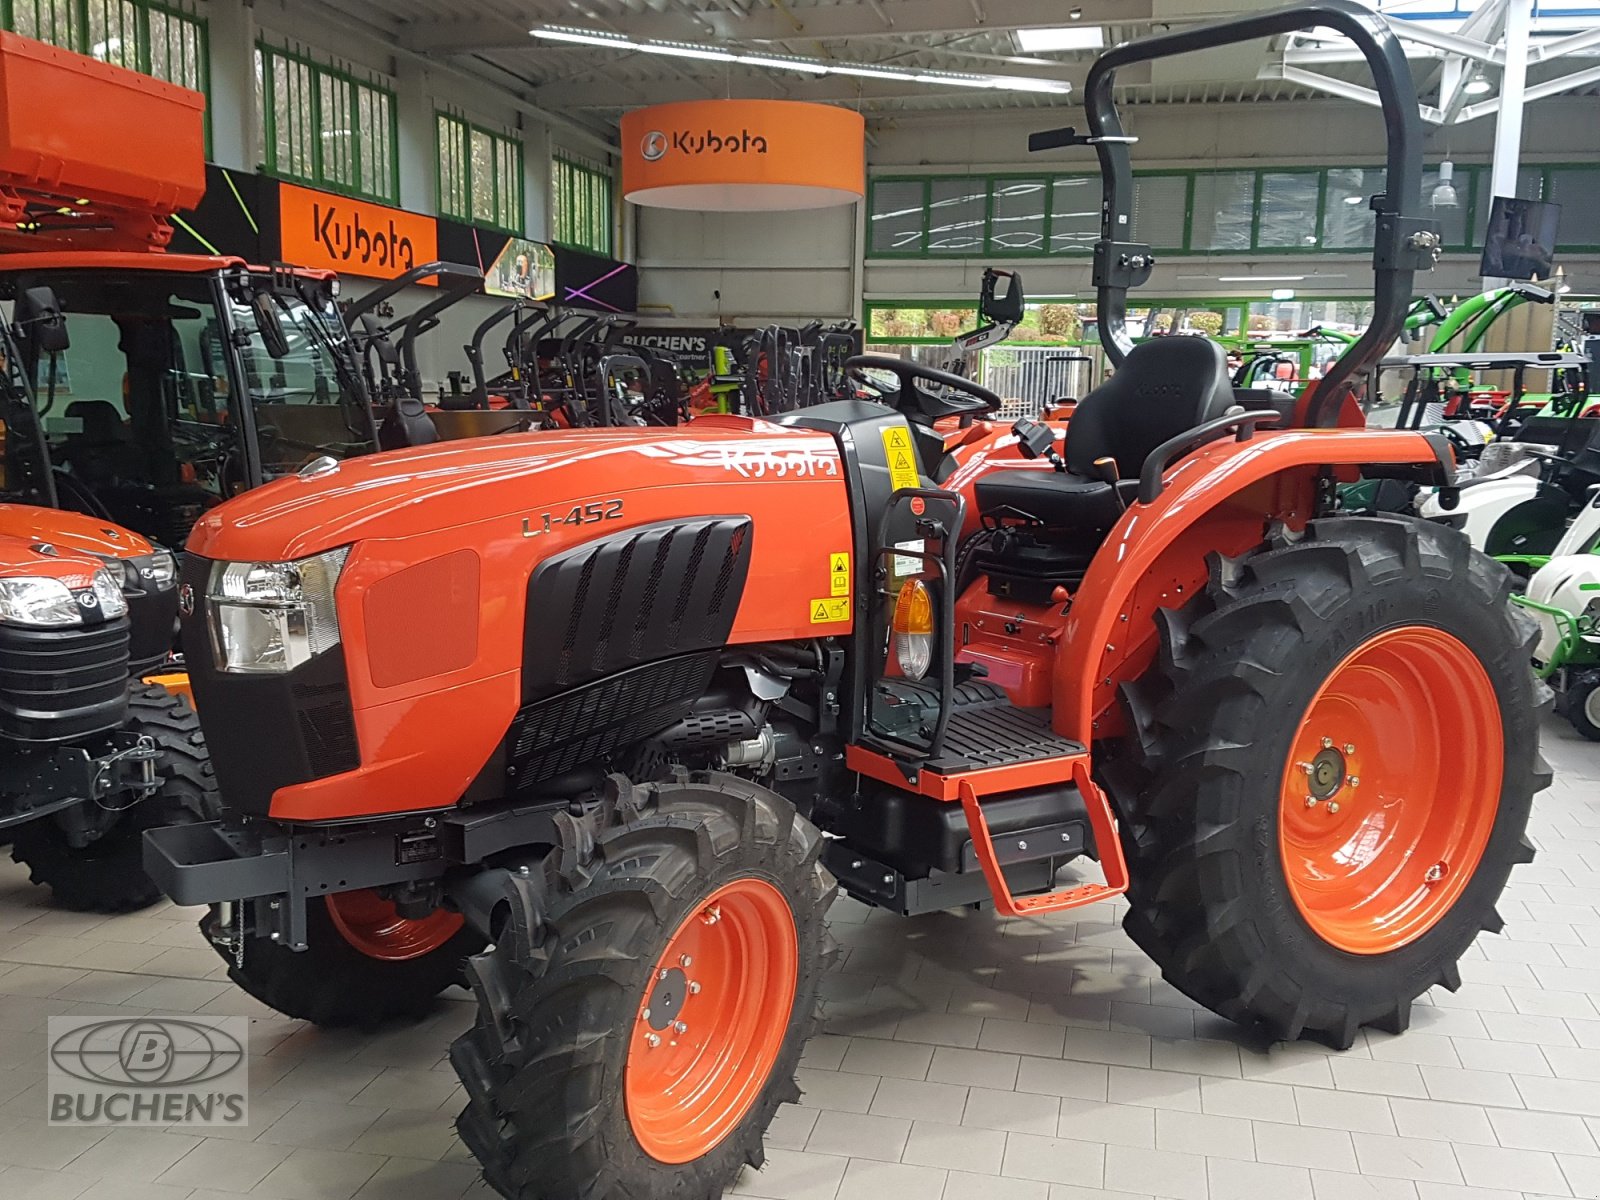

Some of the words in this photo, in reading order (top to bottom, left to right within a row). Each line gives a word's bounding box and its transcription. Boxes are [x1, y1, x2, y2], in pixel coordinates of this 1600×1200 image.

[672, 129, 768, 154] Kubota
[313, 203, 414, 270] Kubota
[623, 336, 706, 351] BUCHEN'S
[723, 449, 837, 478] Kubota
[522, 498, 624, 538] L1-452
